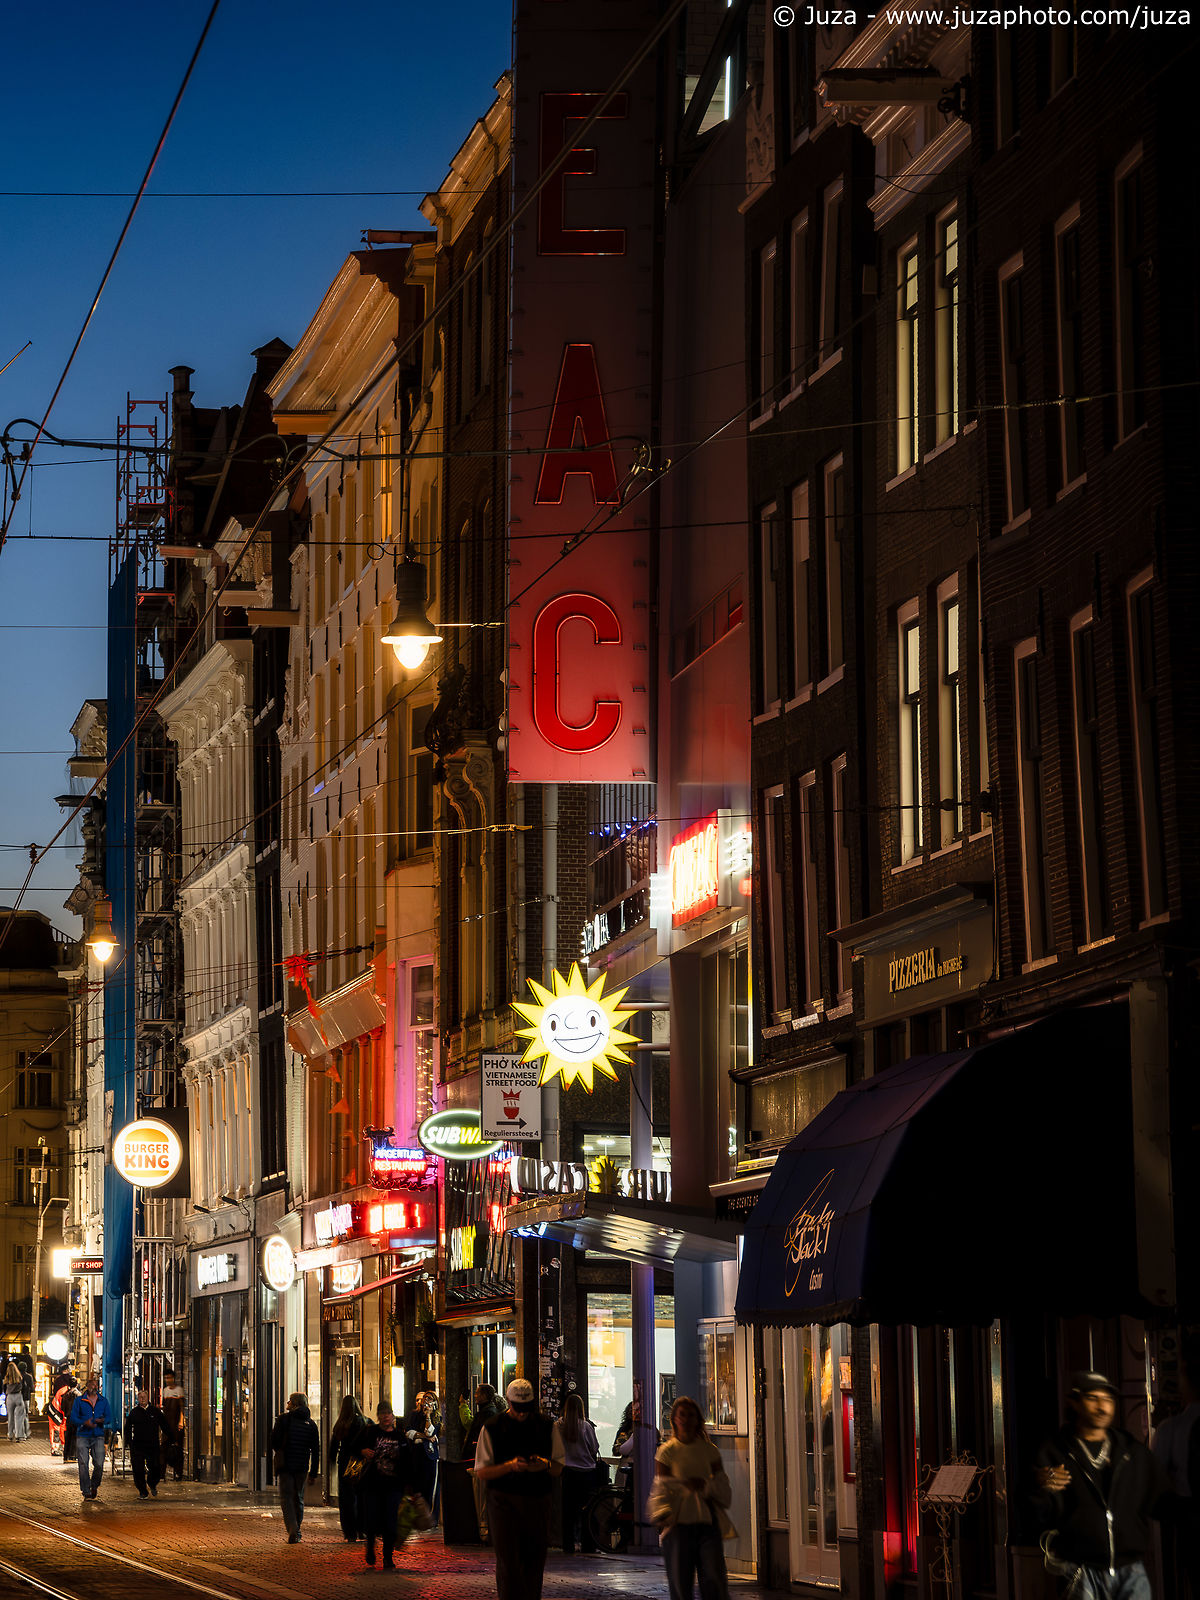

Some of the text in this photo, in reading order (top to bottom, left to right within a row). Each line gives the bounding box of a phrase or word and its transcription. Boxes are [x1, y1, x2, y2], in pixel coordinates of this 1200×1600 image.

[889, 947, 936, 993] PIZZERIA
[485, 1071, 537, 1079] VIETNAMESE
[485, 1079, 537, 1087] STREET FOOD
[424, 1126, 493, 1145] SUBWA
[124, 1143, 170, 1154] BURGER
[124, 1154, 170, 1169] KING
[374, 1161, 426, 1171] RESTAURANT
[71, 1261, 103, 1269] GIFT SHOP
